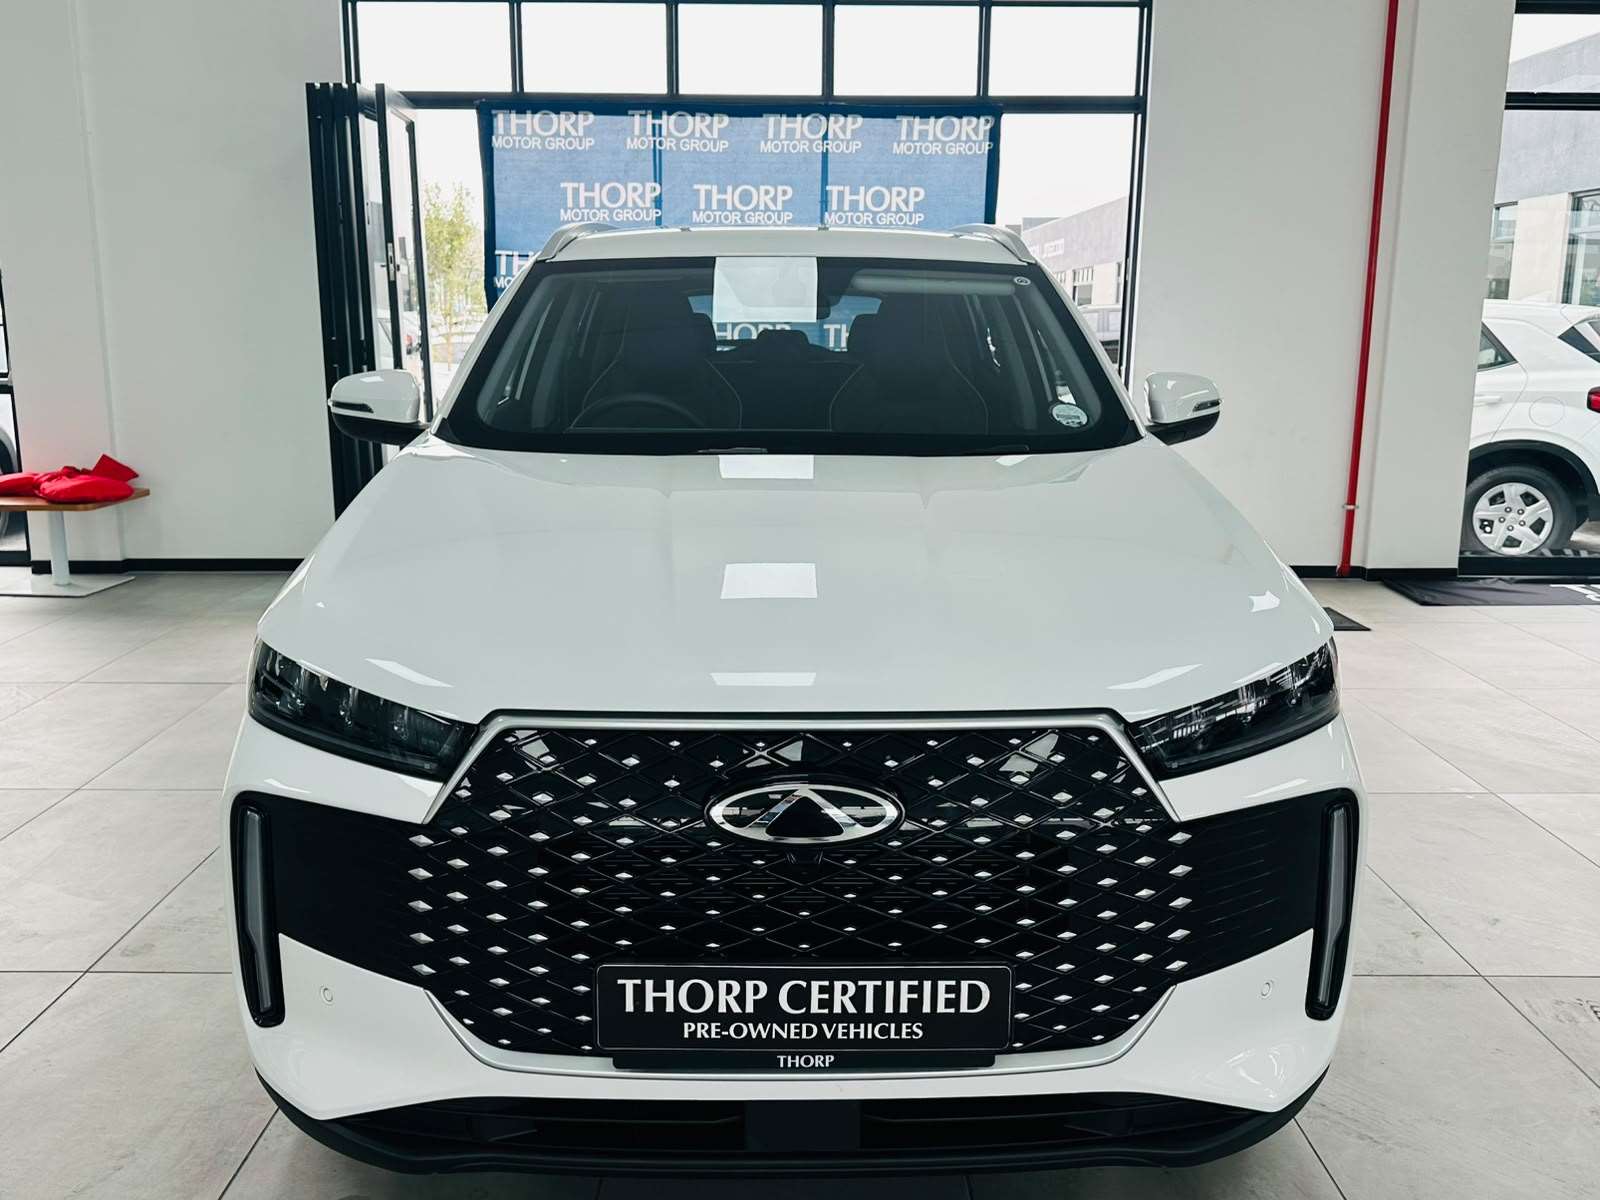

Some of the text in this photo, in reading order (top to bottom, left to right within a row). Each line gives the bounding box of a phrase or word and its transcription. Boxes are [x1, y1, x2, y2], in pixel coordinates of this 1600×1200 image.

[491, 110, 594, 136] THORP
[627, 110, 729, 138] THORP
[762, 113, 863, 140] THORP
[896, 115, 995, 141] THORP
[491, 136, 594, 150] MOTOR GROUP
[626, 137, 729, 152] MOTOR GROUP
[760, 140, 862, 153] MOTOR GROUP
[893, 142, 994, 155] MOTOR GROUP
[560, 182, 662, 208] THORP
[693, 184, 793, 211] THORP
[826, 185, 926, 212] THORP
[560, 208, 662, 222] MOTOR GROUP
[692, 211, 793, 225] MOTOR GROUP
[824, 212, 925, 225] MOTOR GROUP
[617, 978, 992, 1016] THORP CERTIFIED
[683, 1022, 923, 1040] PRE-OWNED VEHICLES
[777, 1055, 835, 1068] THORP
